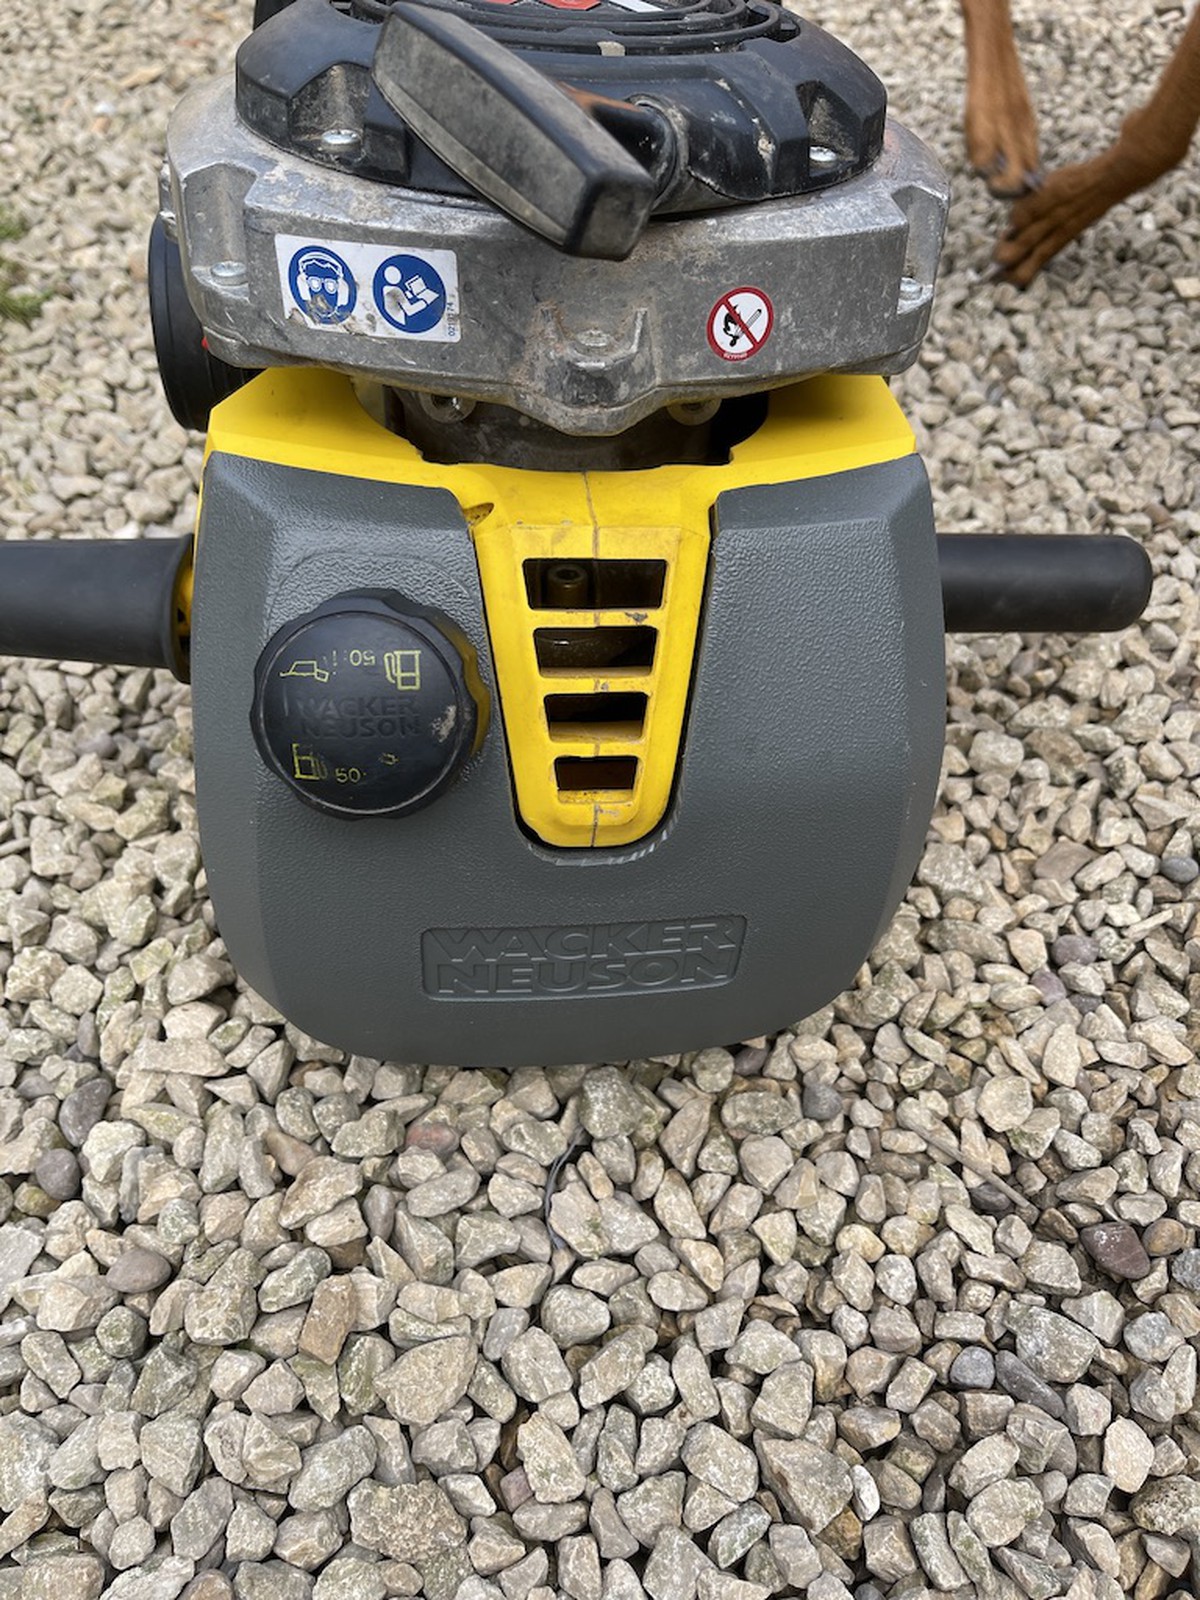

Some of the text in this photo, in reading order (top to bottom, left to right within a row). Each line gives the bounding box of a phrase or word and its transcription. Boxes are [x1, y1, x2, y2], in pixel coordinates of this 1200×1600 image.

[297, 697, 420, 718] WACKER
[301, 717, 419, 739] NEUSON
[430, 919, 736, 961] WACKER
[437, 956, 729, 993] NEUSON
